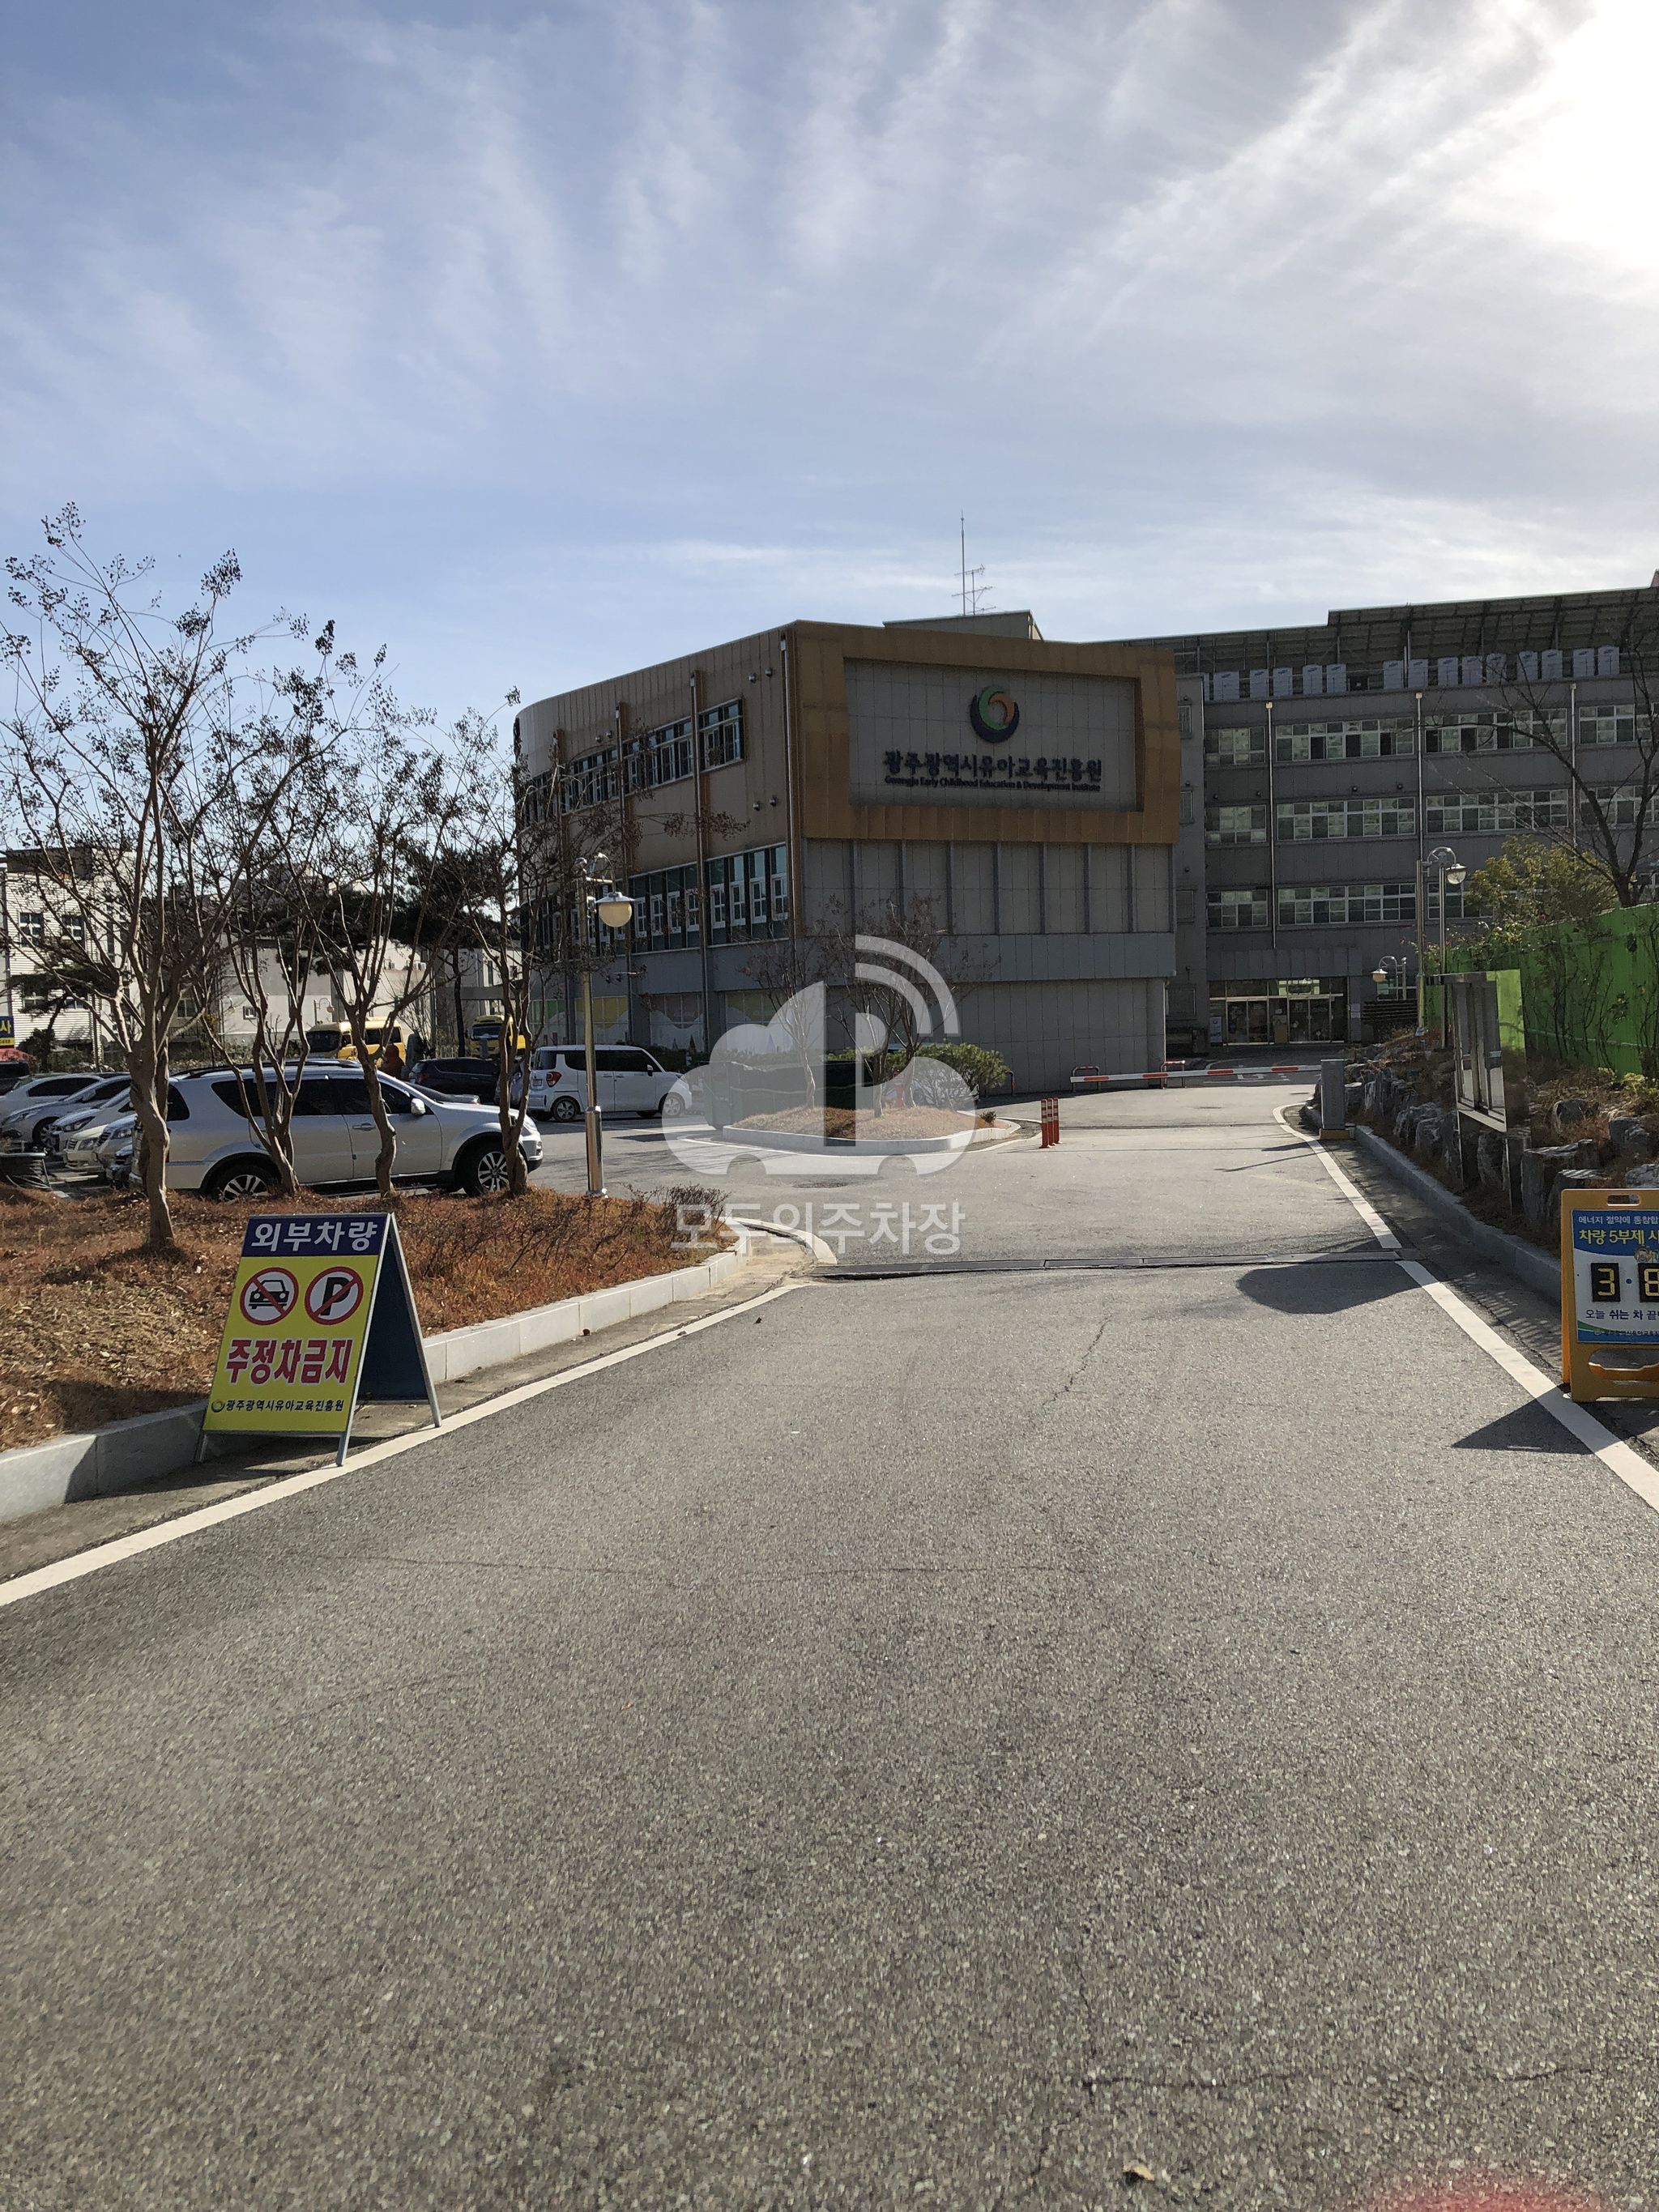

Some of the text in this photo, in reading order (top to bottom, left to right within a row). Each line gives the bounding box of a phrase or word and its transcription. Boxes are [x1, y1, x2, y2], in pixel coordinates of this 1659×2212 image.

[884, 750, 1102, 782] 광주광역시유아교육진흥원
[1578, 1216, 1603, 1225] 에너지
[1606, 1216, 1631, 1225] 절약에
[251, 1221, 377, 1252] 외부차량
[1579, 1229, 1606, 1245] 차량
[1609, 1230, 1645, 1245] 5부제
[1585, 1309, 1606, 1319] 오늘
[1609, 1309, 1630, 1320] 쉬는
[1633, 1309, 1644, 1320] 차
[226, 1339, 353, 1386] 주정차금지
[225, 1399, 343, 1413] 광주광역시유아교육진흥원
